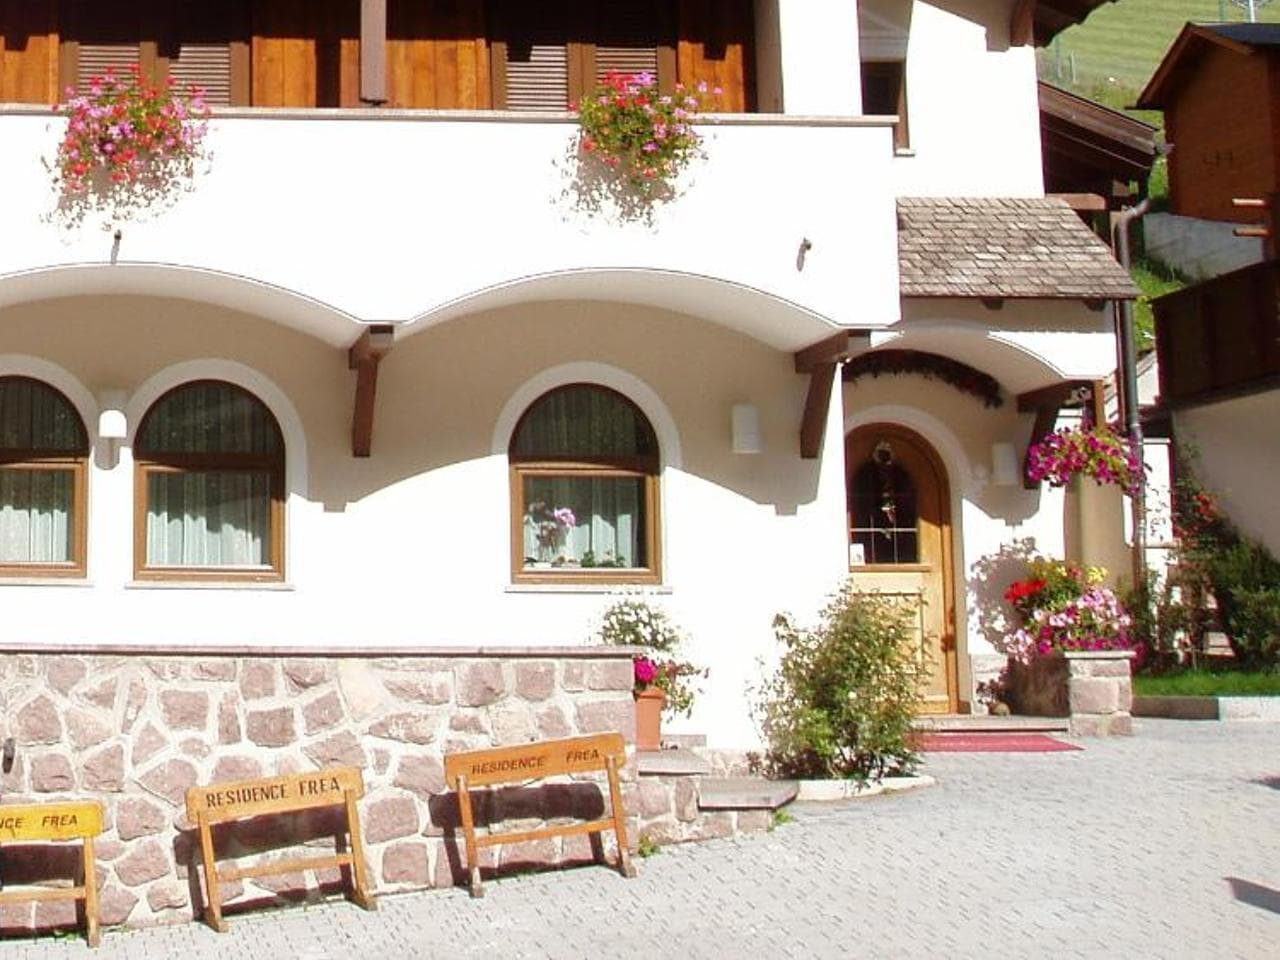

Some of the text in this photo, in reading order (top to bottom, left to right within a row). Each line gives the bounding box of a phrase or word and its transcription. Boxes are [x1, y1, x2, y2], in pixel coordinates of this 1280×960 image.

[471, 749, 600, 775] RESIDENCE FREA
[205, 776, 341, 808] RESIDENCE FREA
[41, 814, 78, 827] FREA
